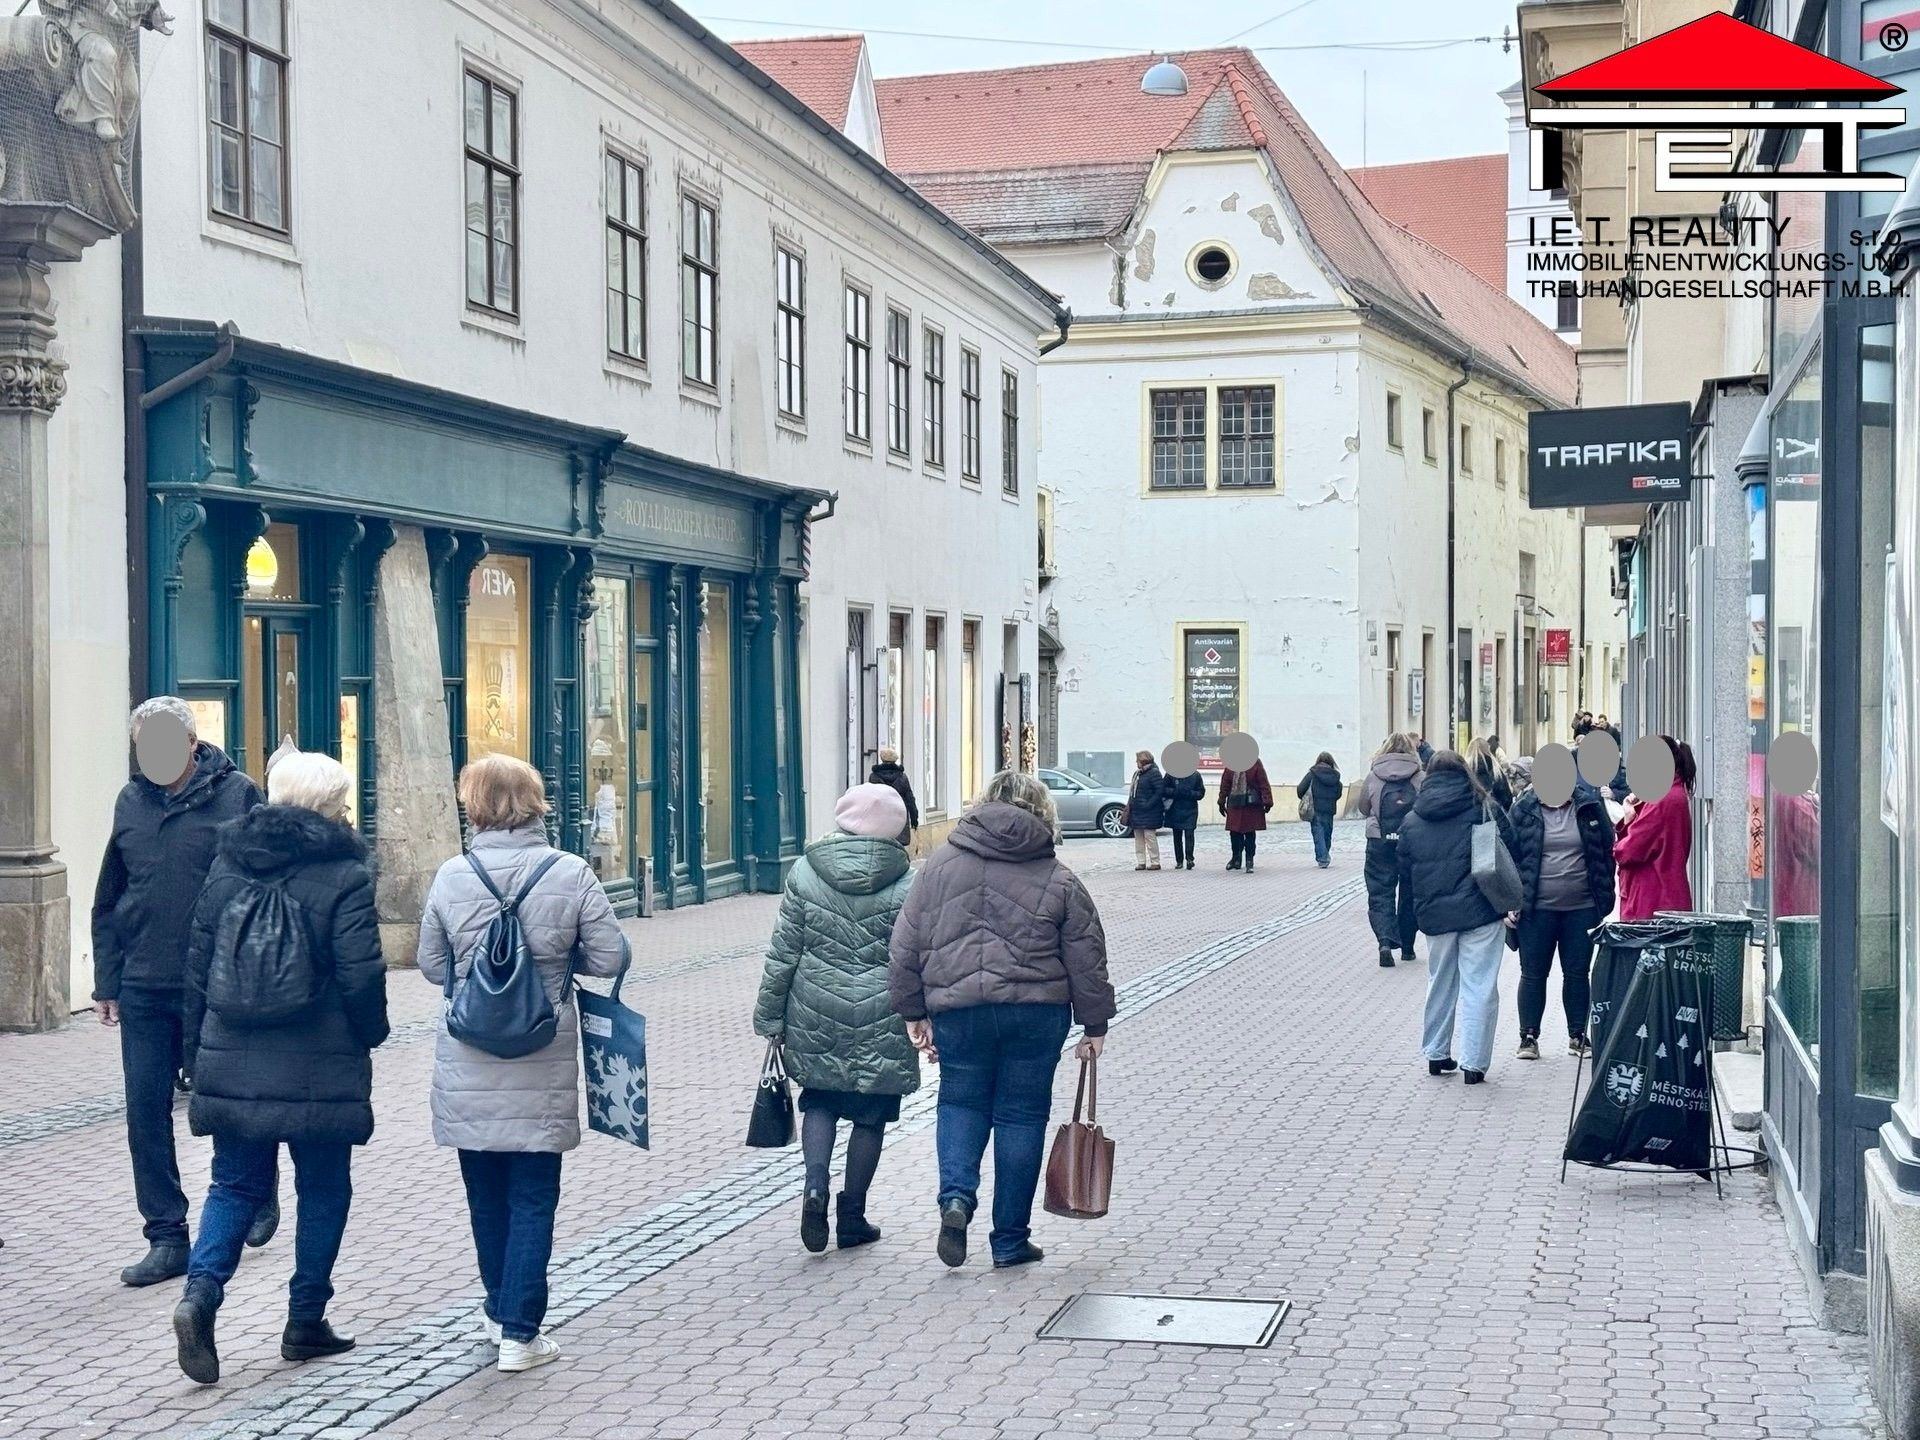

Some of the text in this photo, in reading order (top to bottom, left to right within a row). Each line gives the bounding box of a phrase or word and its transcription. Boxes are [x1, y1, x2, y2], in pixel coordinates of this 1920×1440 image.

[1537, 438, 1682, 468] TRAFIKA
[625, 498, 662, 530] ROYAL
[663, 505, 702, 537] BARBER
[711, 514, 737, 542] SHOP
[1651, 1080, 1704, 1100] MĚSTSKÁ
